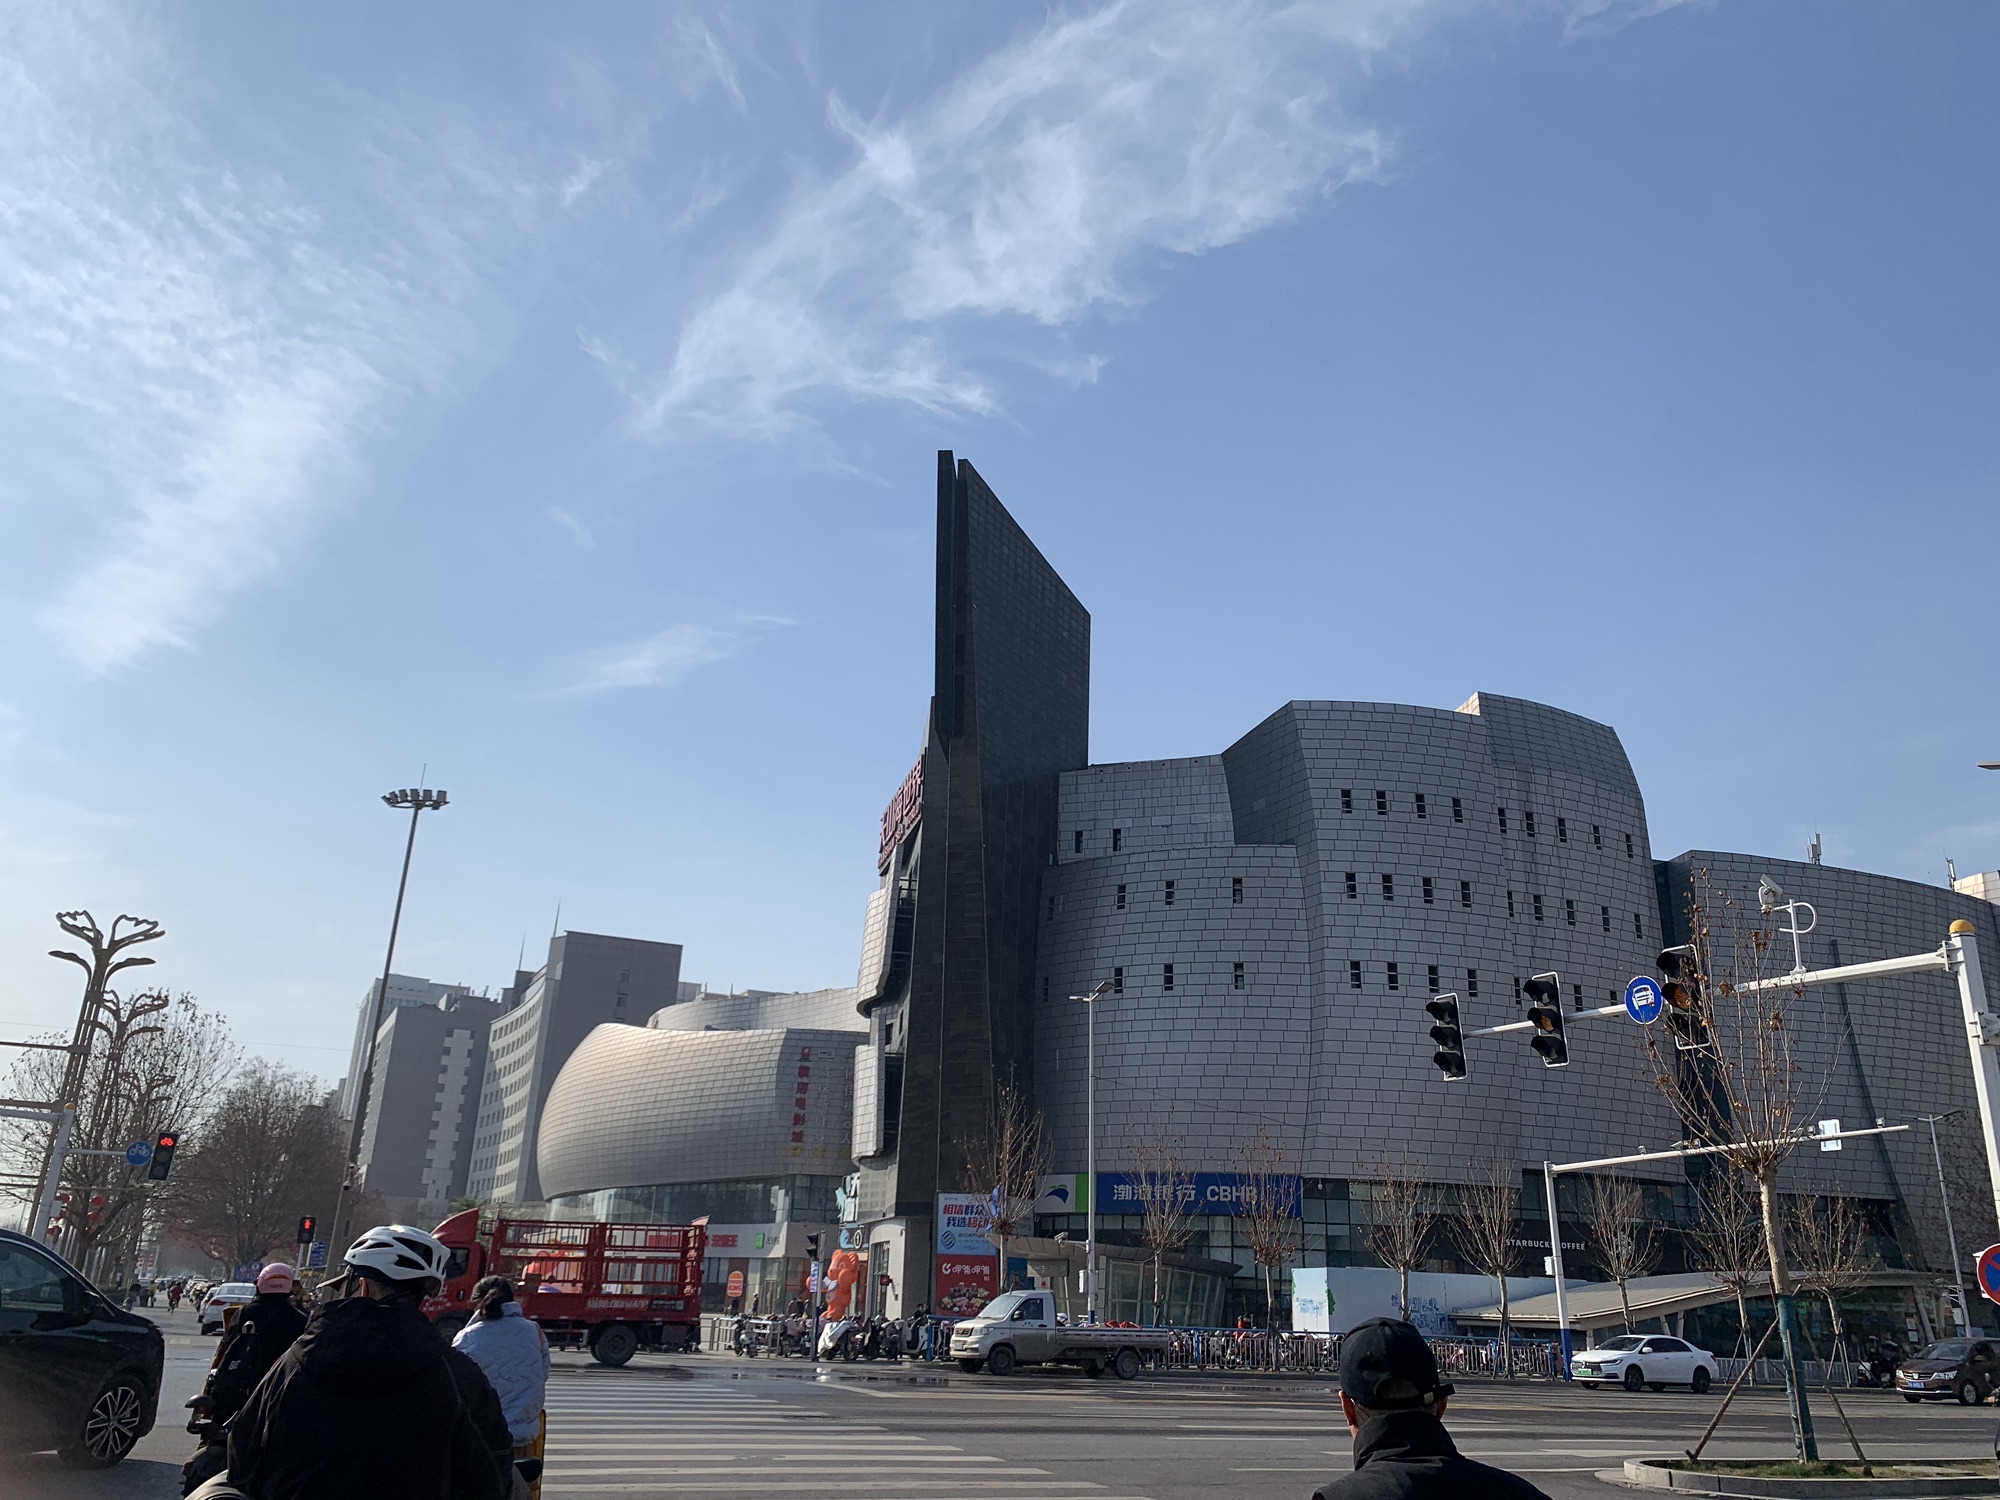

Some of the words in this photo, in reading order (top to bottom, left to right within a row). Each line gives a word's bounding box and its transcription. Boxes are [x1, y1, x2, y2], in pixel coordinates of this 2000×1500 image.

[1113, 1184, 1196, 1202] 渤海银行
[1206, 1185, 1257, 1203] CBHB
[943, 1204, 986, 1216] 相信群众
[946, 1216, 990, 1228] 我选移动
[1561, 1242, 1586, 1251] OFFEE
[952, 1264, 990, 1276] 呷哺呷哺
